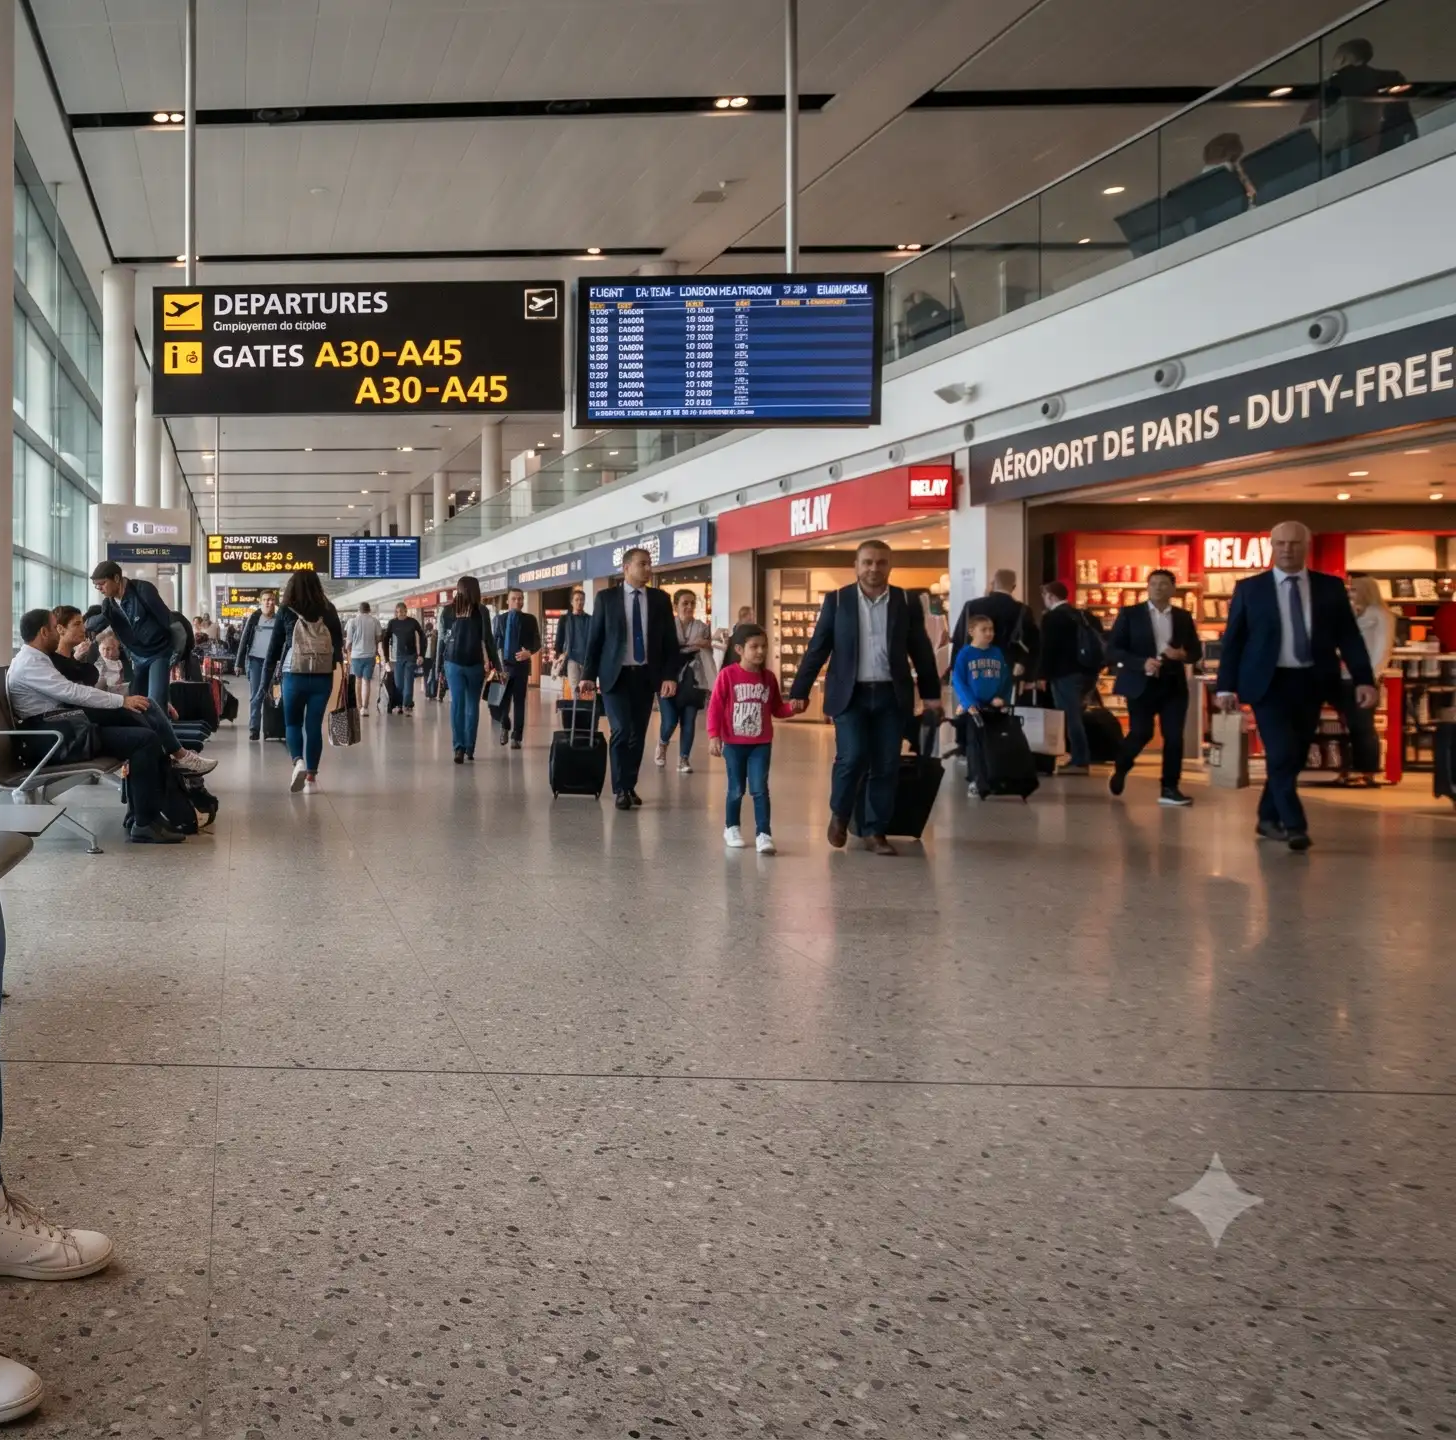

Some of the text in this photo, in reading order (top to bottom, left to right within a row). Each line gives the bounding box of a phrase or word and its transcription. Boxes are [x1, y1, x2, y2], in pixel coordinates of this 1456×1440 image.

[213, 291, 388, 316] DEPARTURES
[213, 340, 462, 368] GATES A30-A45
[355, 376, 508, 405] A30-A45
[990, 434, 1097, 485] AÉROPORT
[1103, 425, 1135, 462] DE
[1142, 404, 1219, 453] PARIS
[1246, 346, 1456, 430] DUTY-FREE
